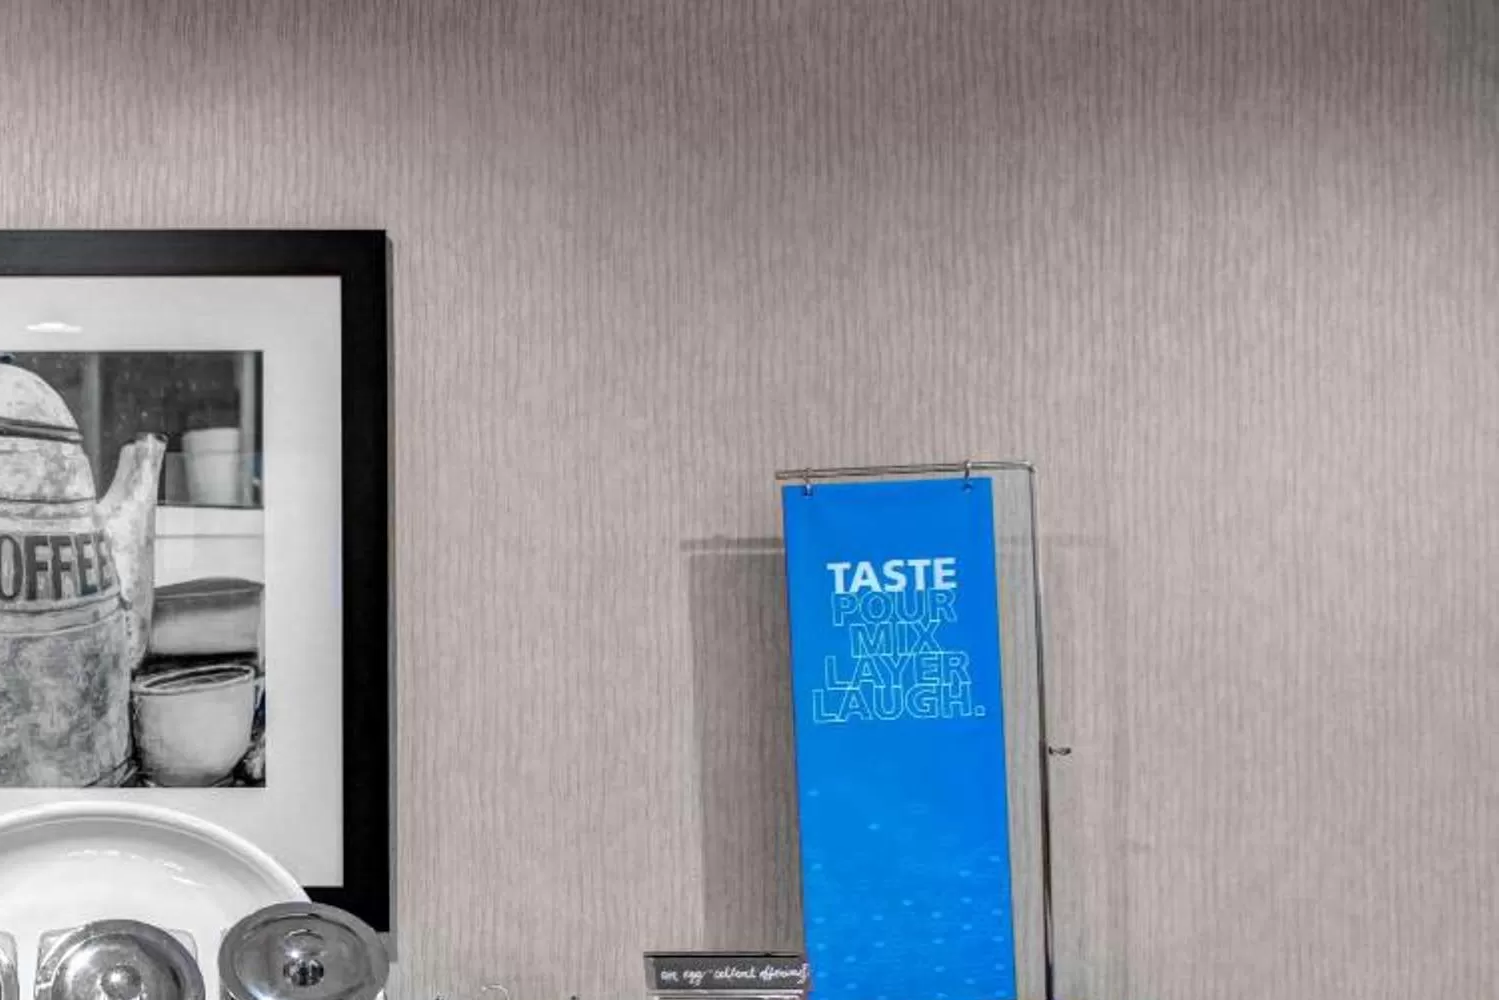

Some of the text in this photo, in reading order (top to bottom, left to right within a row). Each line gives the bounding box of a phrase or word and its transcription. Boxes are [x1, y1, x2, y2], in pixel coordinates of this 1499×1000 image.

[826, 557, 958, 595] TASTE
[831, 587, 958, 627] POUR
[850, 618, 944, 659] MIX
[824, 650, 973, 691] LAYER
[812, 682, 987, 724] LAUGH.
